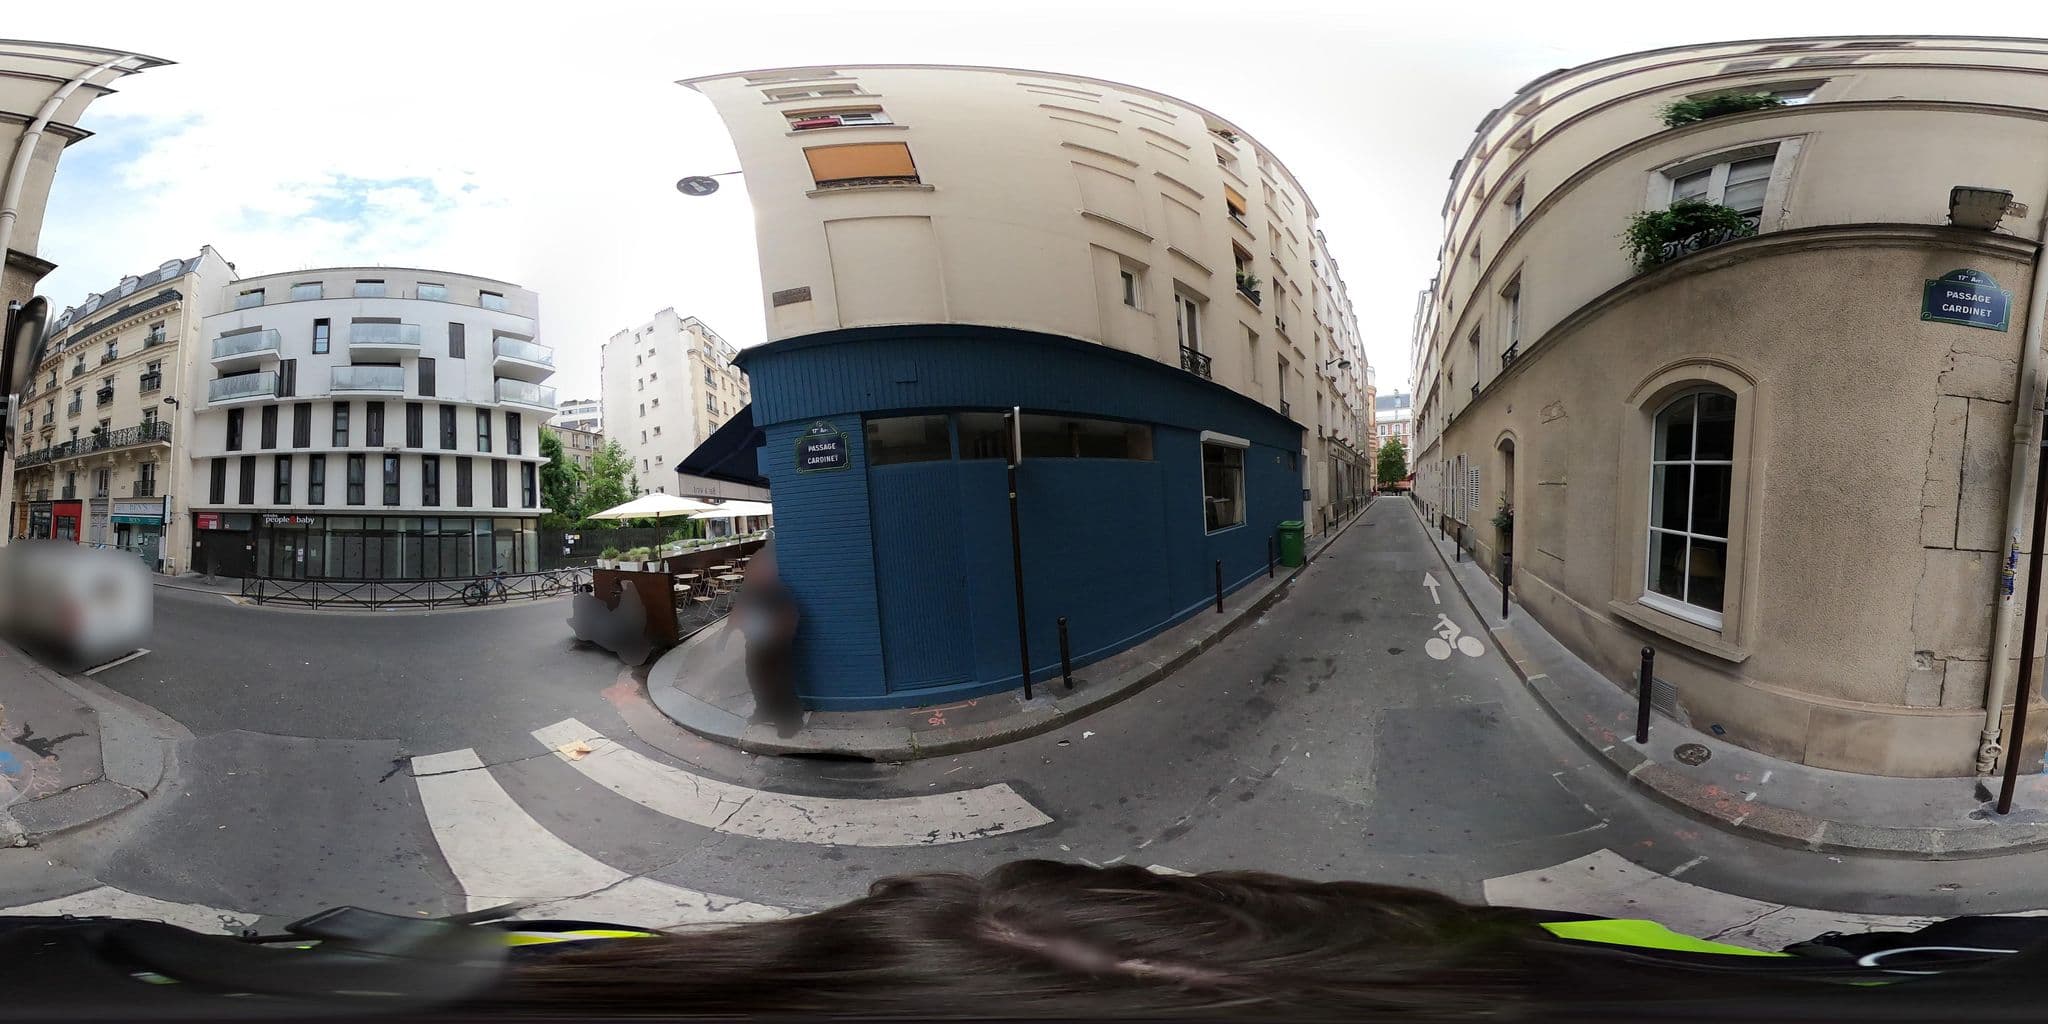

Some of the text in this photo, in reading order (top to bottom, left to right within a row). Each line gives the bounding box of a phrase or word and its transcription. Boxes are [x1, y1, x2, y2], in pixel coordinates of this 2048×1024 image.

[1946, 290, 1991, 304] PASSAGE
[1942, 303, 1992, 318] CARDINET
[807, 442, 836, 452] PASSAGE
[807, 454, 838, 465] CARDINET
[265, 515, 290, 524] people
[296, 515, 314, 525] baby
